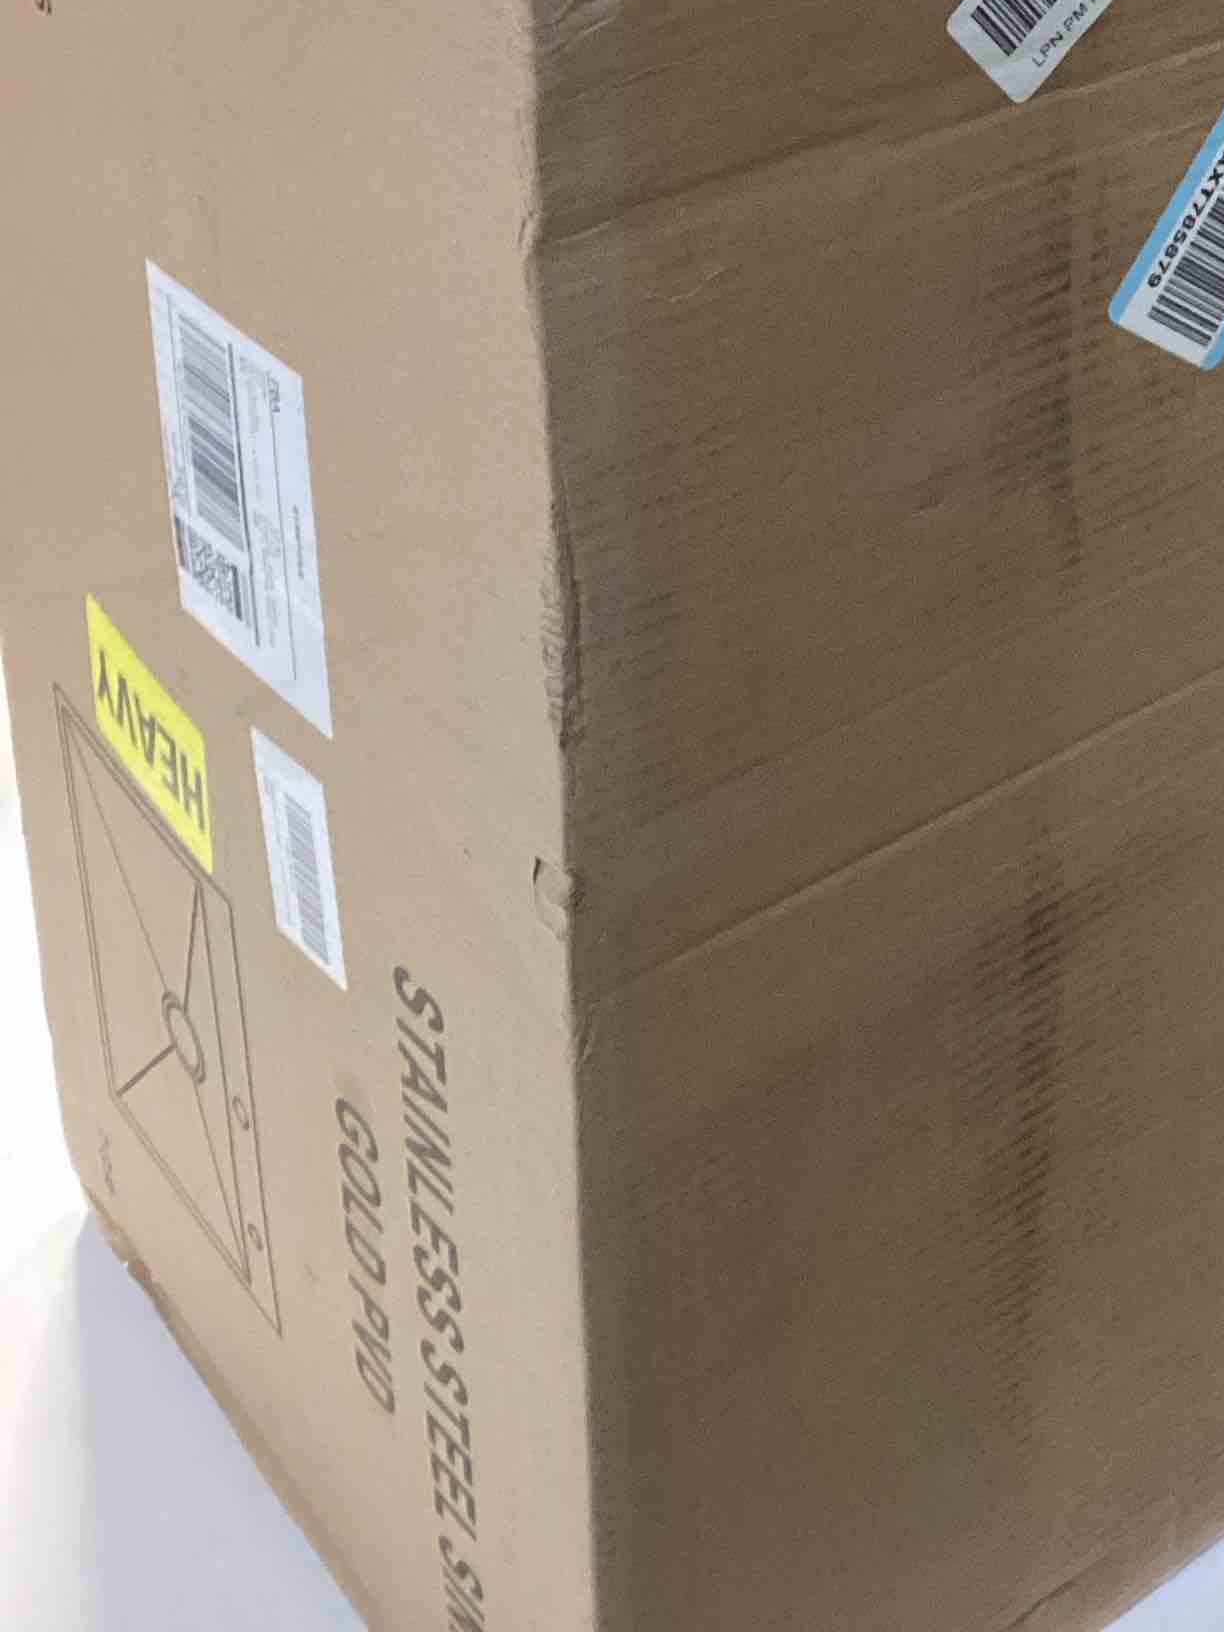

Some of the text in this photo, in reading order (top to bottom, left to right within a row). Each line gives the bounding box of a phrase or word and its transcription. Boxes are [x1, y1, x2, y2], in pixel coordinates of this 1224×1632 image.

[1031, 30, 1065, 68] LPN
[1063, 2, 1089, 32] PM
[97, 643, 206, 835] HEAVY
[335, 1097, 396, 1415] GOLD PVD
[393, 964, 487, 1632] STAINLESS STEEL SIN
